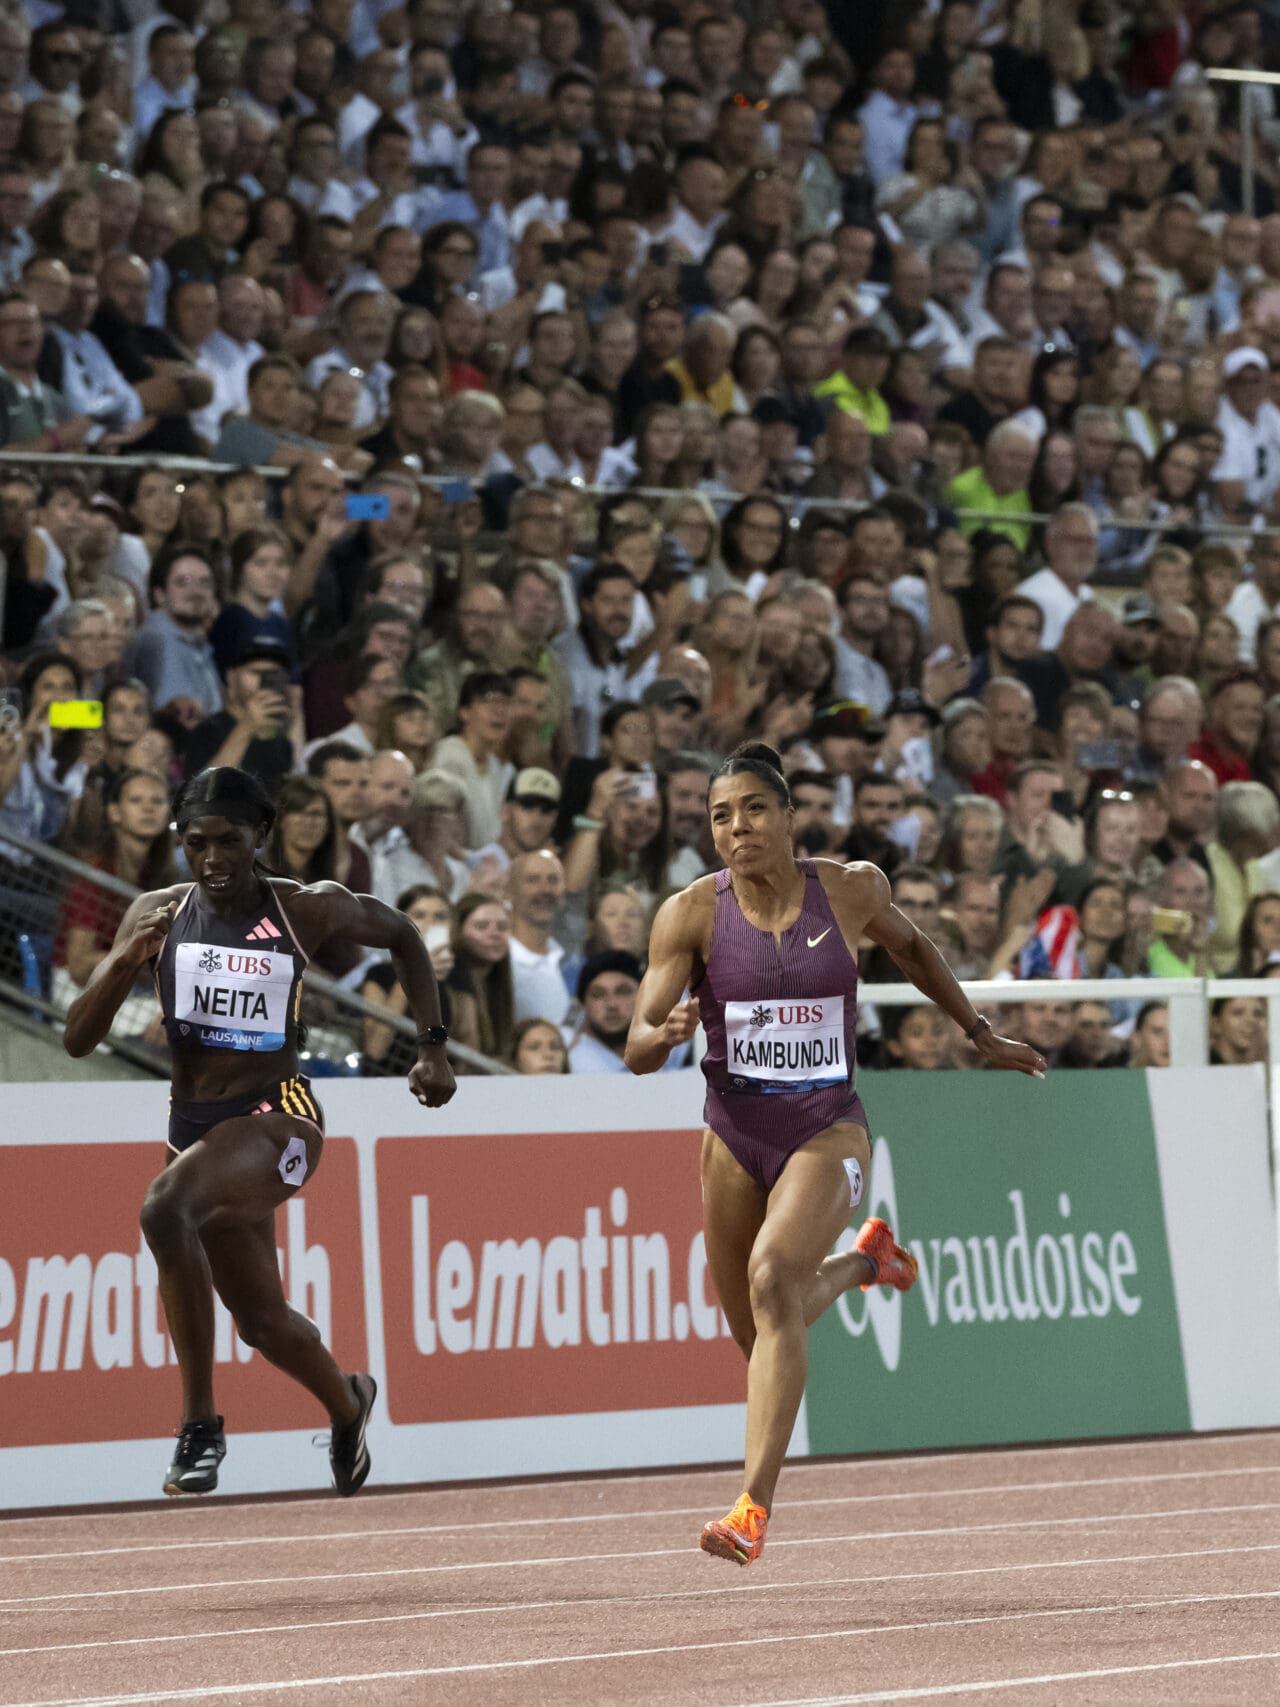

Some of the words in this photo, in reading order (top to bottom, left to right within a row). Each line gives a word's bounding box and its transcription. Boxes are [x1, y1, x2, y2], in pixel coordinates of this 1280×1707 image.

[227, 954, 272, 976] UBS
[193, 985, 269, 1020] NEITA
[777, 1005, 823, 1025] UBS
[200, 1030, 263, 1046] LAUSANNE
[733, 1037, 839, 1069] KAMBUNDJI
[411, 1187, 733, 1355] lematin.c
[908, 1189, 1141, 1327] vaudoise
